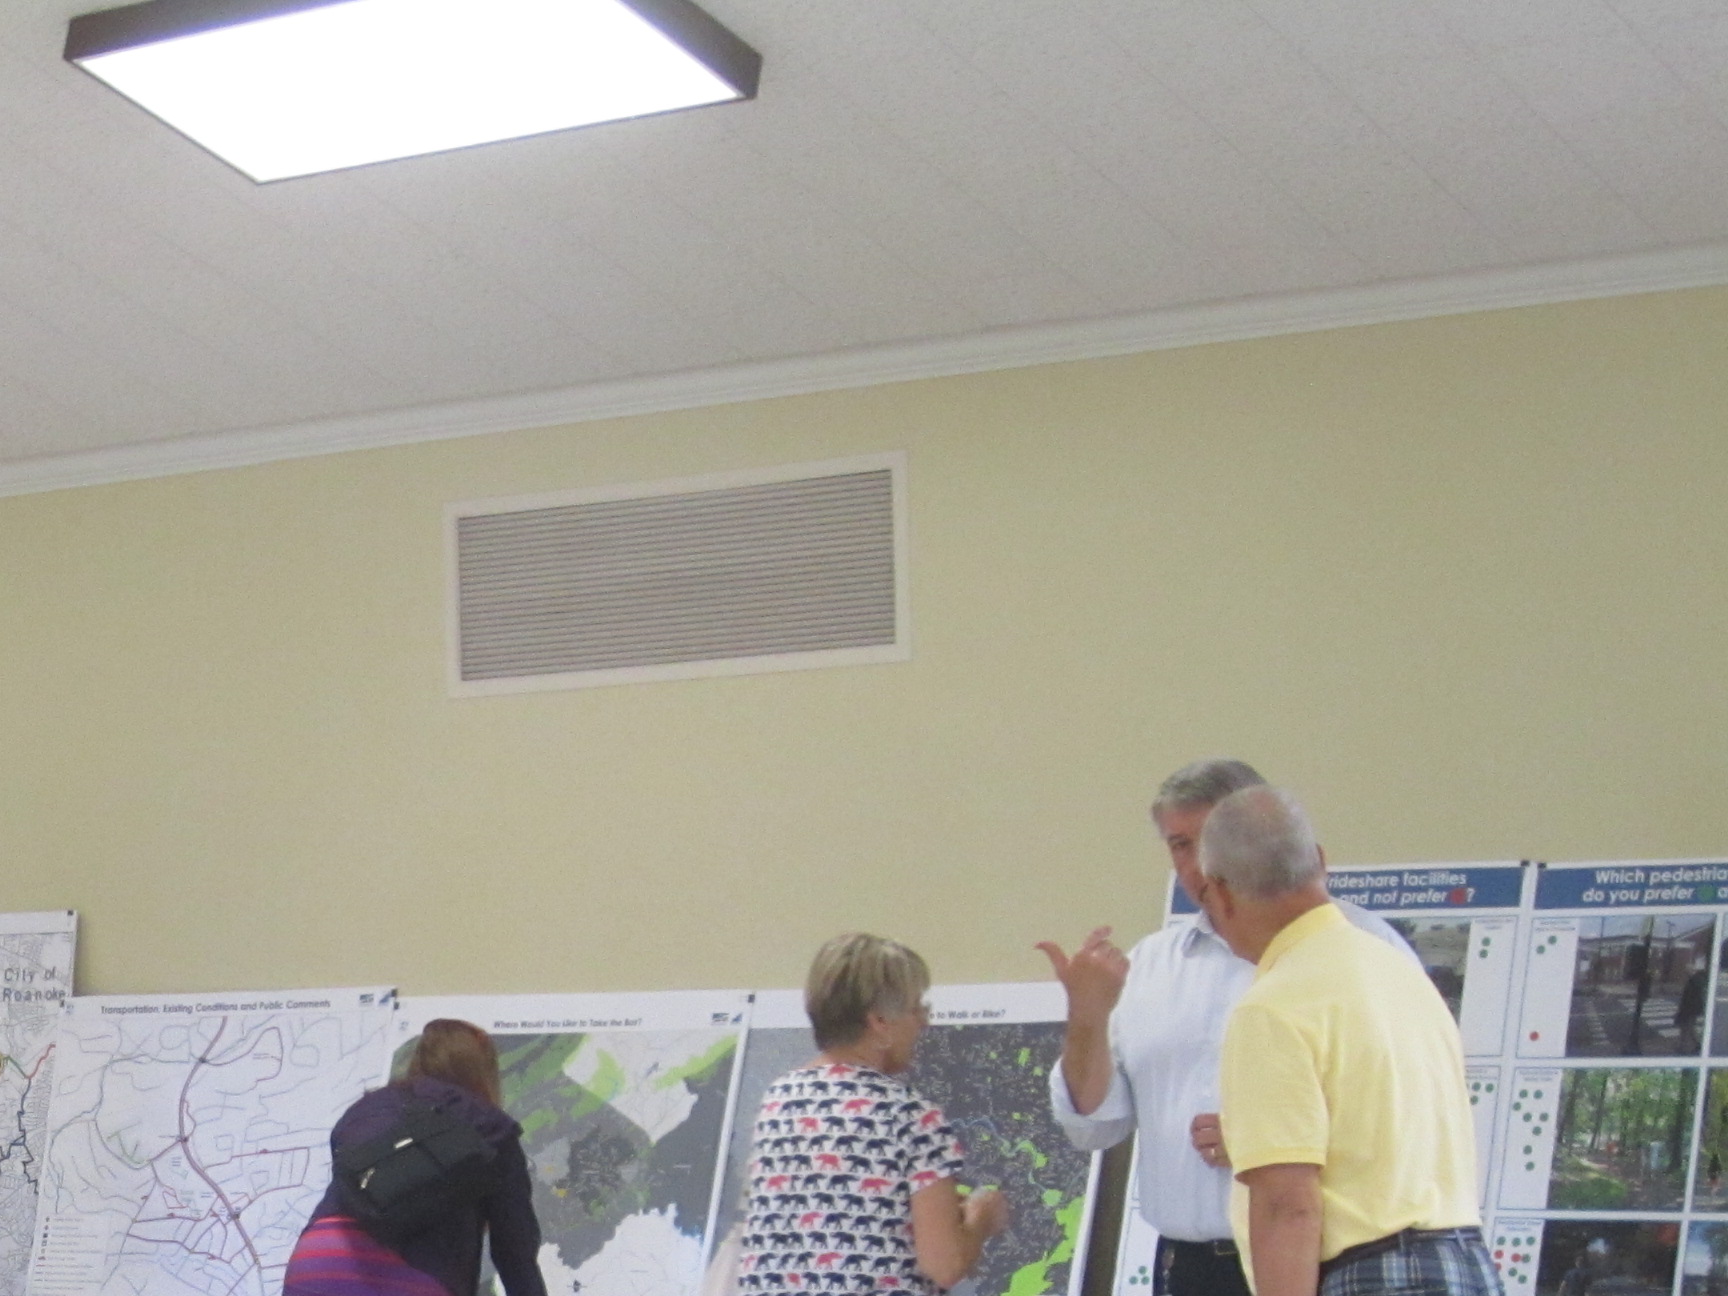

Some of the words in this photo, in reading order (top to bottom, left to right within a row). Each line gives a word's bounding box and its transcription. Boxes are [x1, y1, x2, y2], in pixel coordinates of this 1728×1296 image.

[1328, 873, 1400, 889] rideshare
[1402, 870, 1467, 887] facilities
[1595, 869, 1645, 885] Which
[1648, 866, 1728, 888] pedestria
[1373, 890, 1398, 904] not
[1399, 887, 1448, 906] prefer
[1582, 887, 1605, 902] do
[1609, 888, 1640, 905] you
[1643, 885, 1694, 905] prefer
[2, 986, 67, 1001] Roanoke
